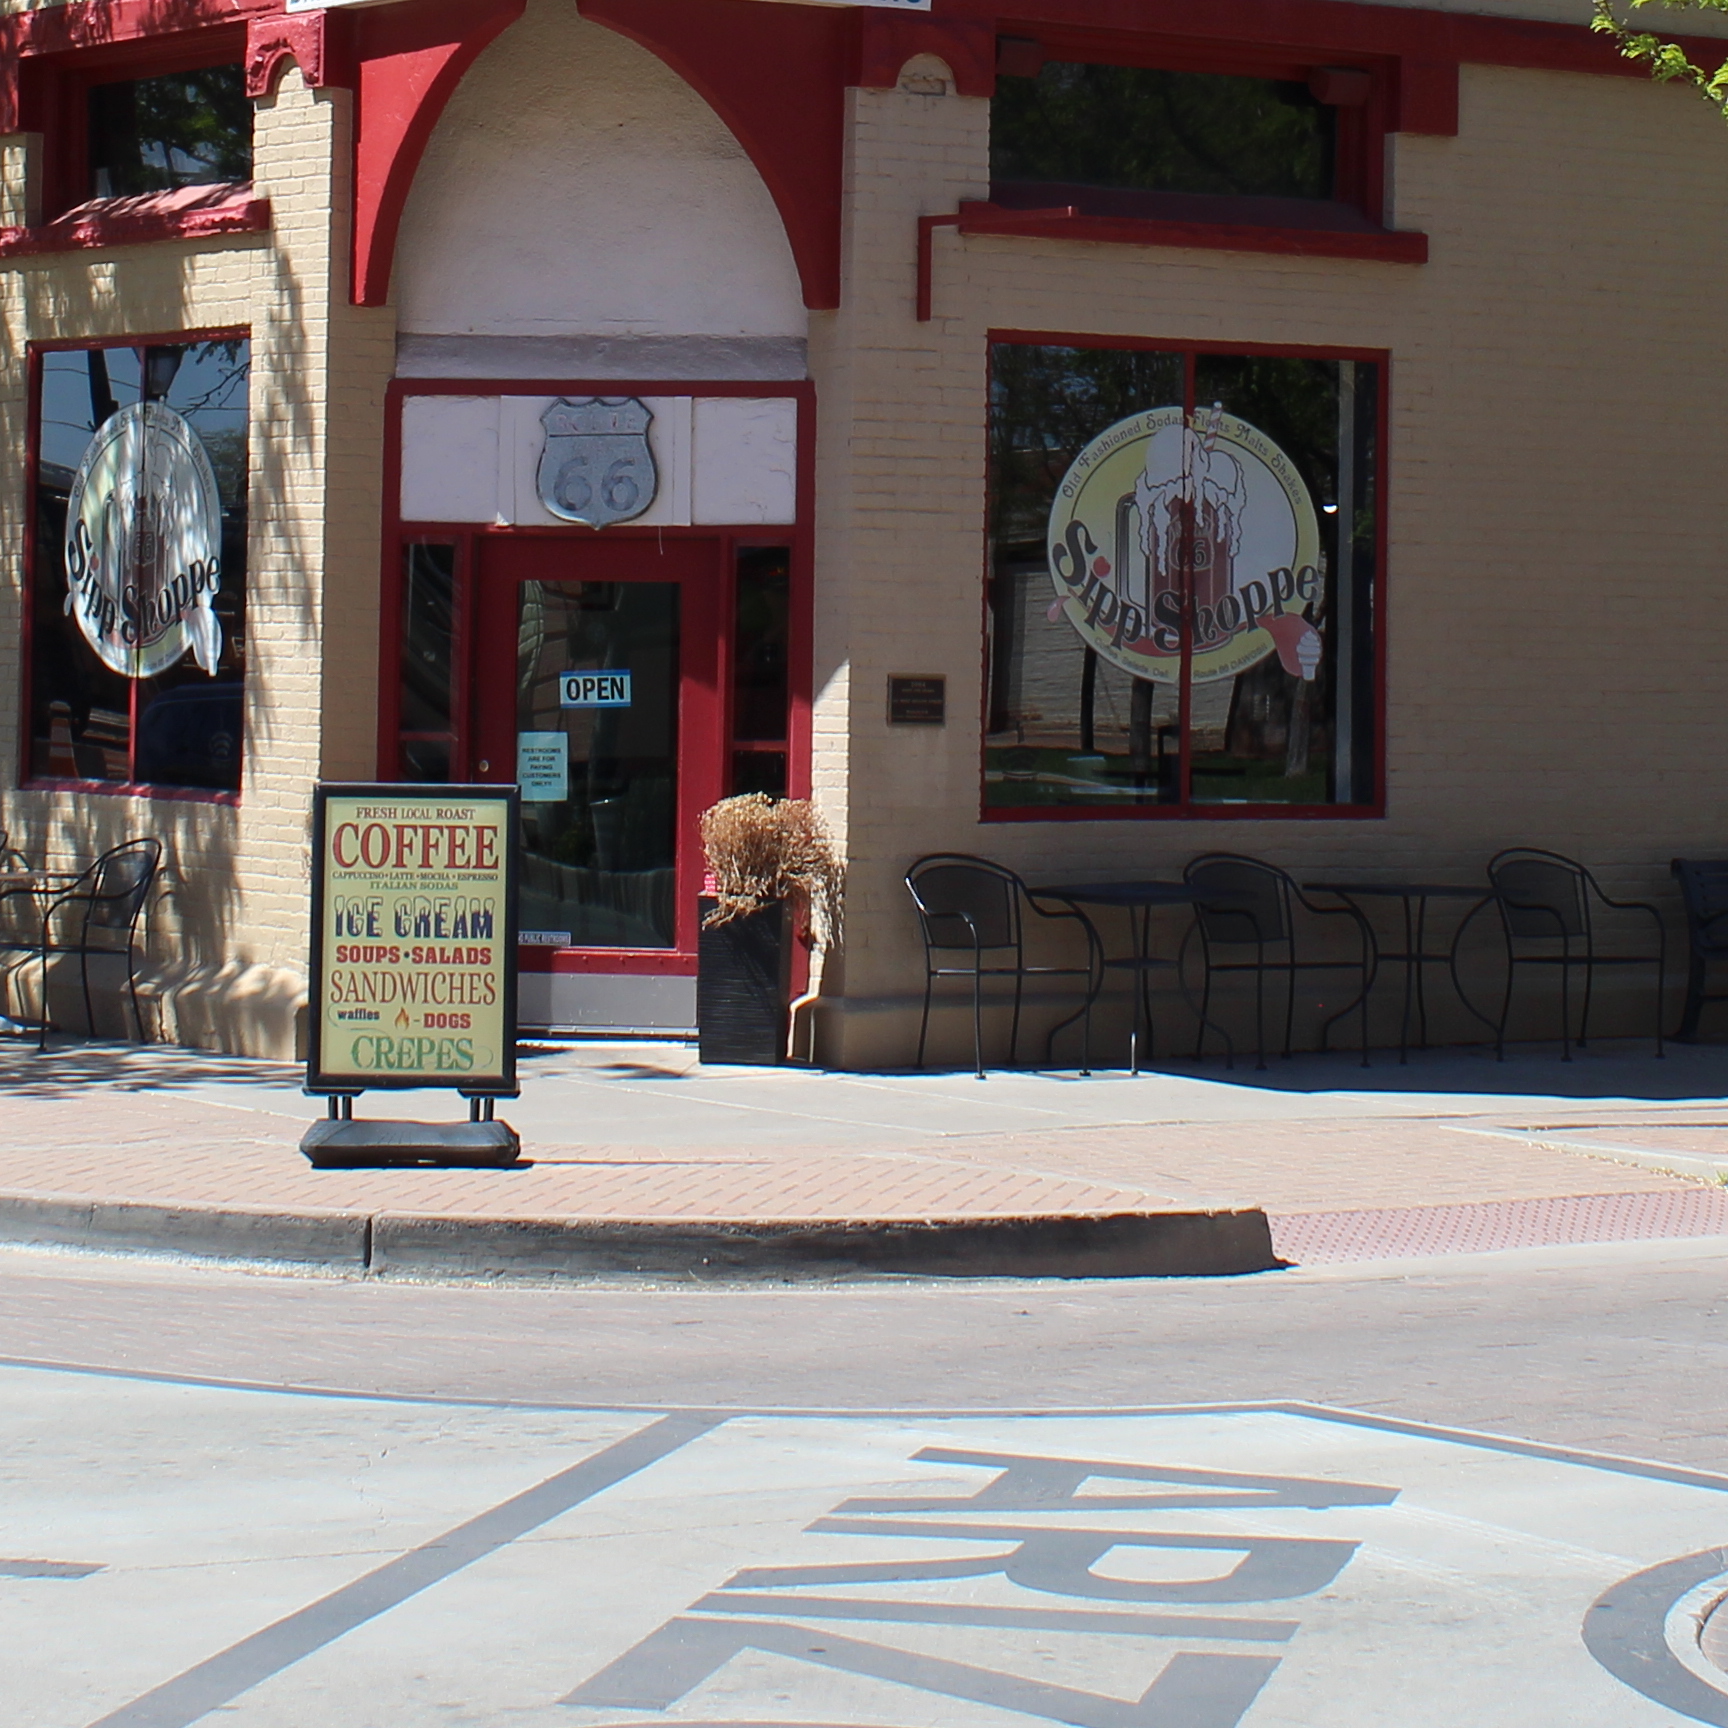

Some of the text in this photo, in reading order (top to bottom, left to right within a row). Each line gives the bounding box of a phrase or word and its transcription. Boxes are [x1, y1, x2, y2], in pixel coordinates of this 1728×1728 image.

[553, 456, 640, 512] 66
[1062, 474, 1083, 499] Old
[1077, 421, 1142, 469] Fashioned
[1234, 423, 1269, 457] Malts
[1270, 453, 1303, 506] Shakes
[68, 518, 223, 645] Sipp Shoppe
[1052, 519, 1321, 653] Sipp Shoppe
[566, 676, 625, 701] OPEN
[356, 807, 476, 820] FRESH LOCAL ROAST
[332, 822, 499, 870] COFFEE
[370, 881, 459, 891] ITALIAN SODAS
[334, 895, 495, 940] ICE CREAM
[336, 945, 492, 966] SOUPS SALADS
[330, 969, 497, 1006] SANDWICHES
[337, 1007, 380, 1021] waffles
[351, 1035, 475, 1072] CREPES
[555, 1446, 1403, 1728] ARIZ
